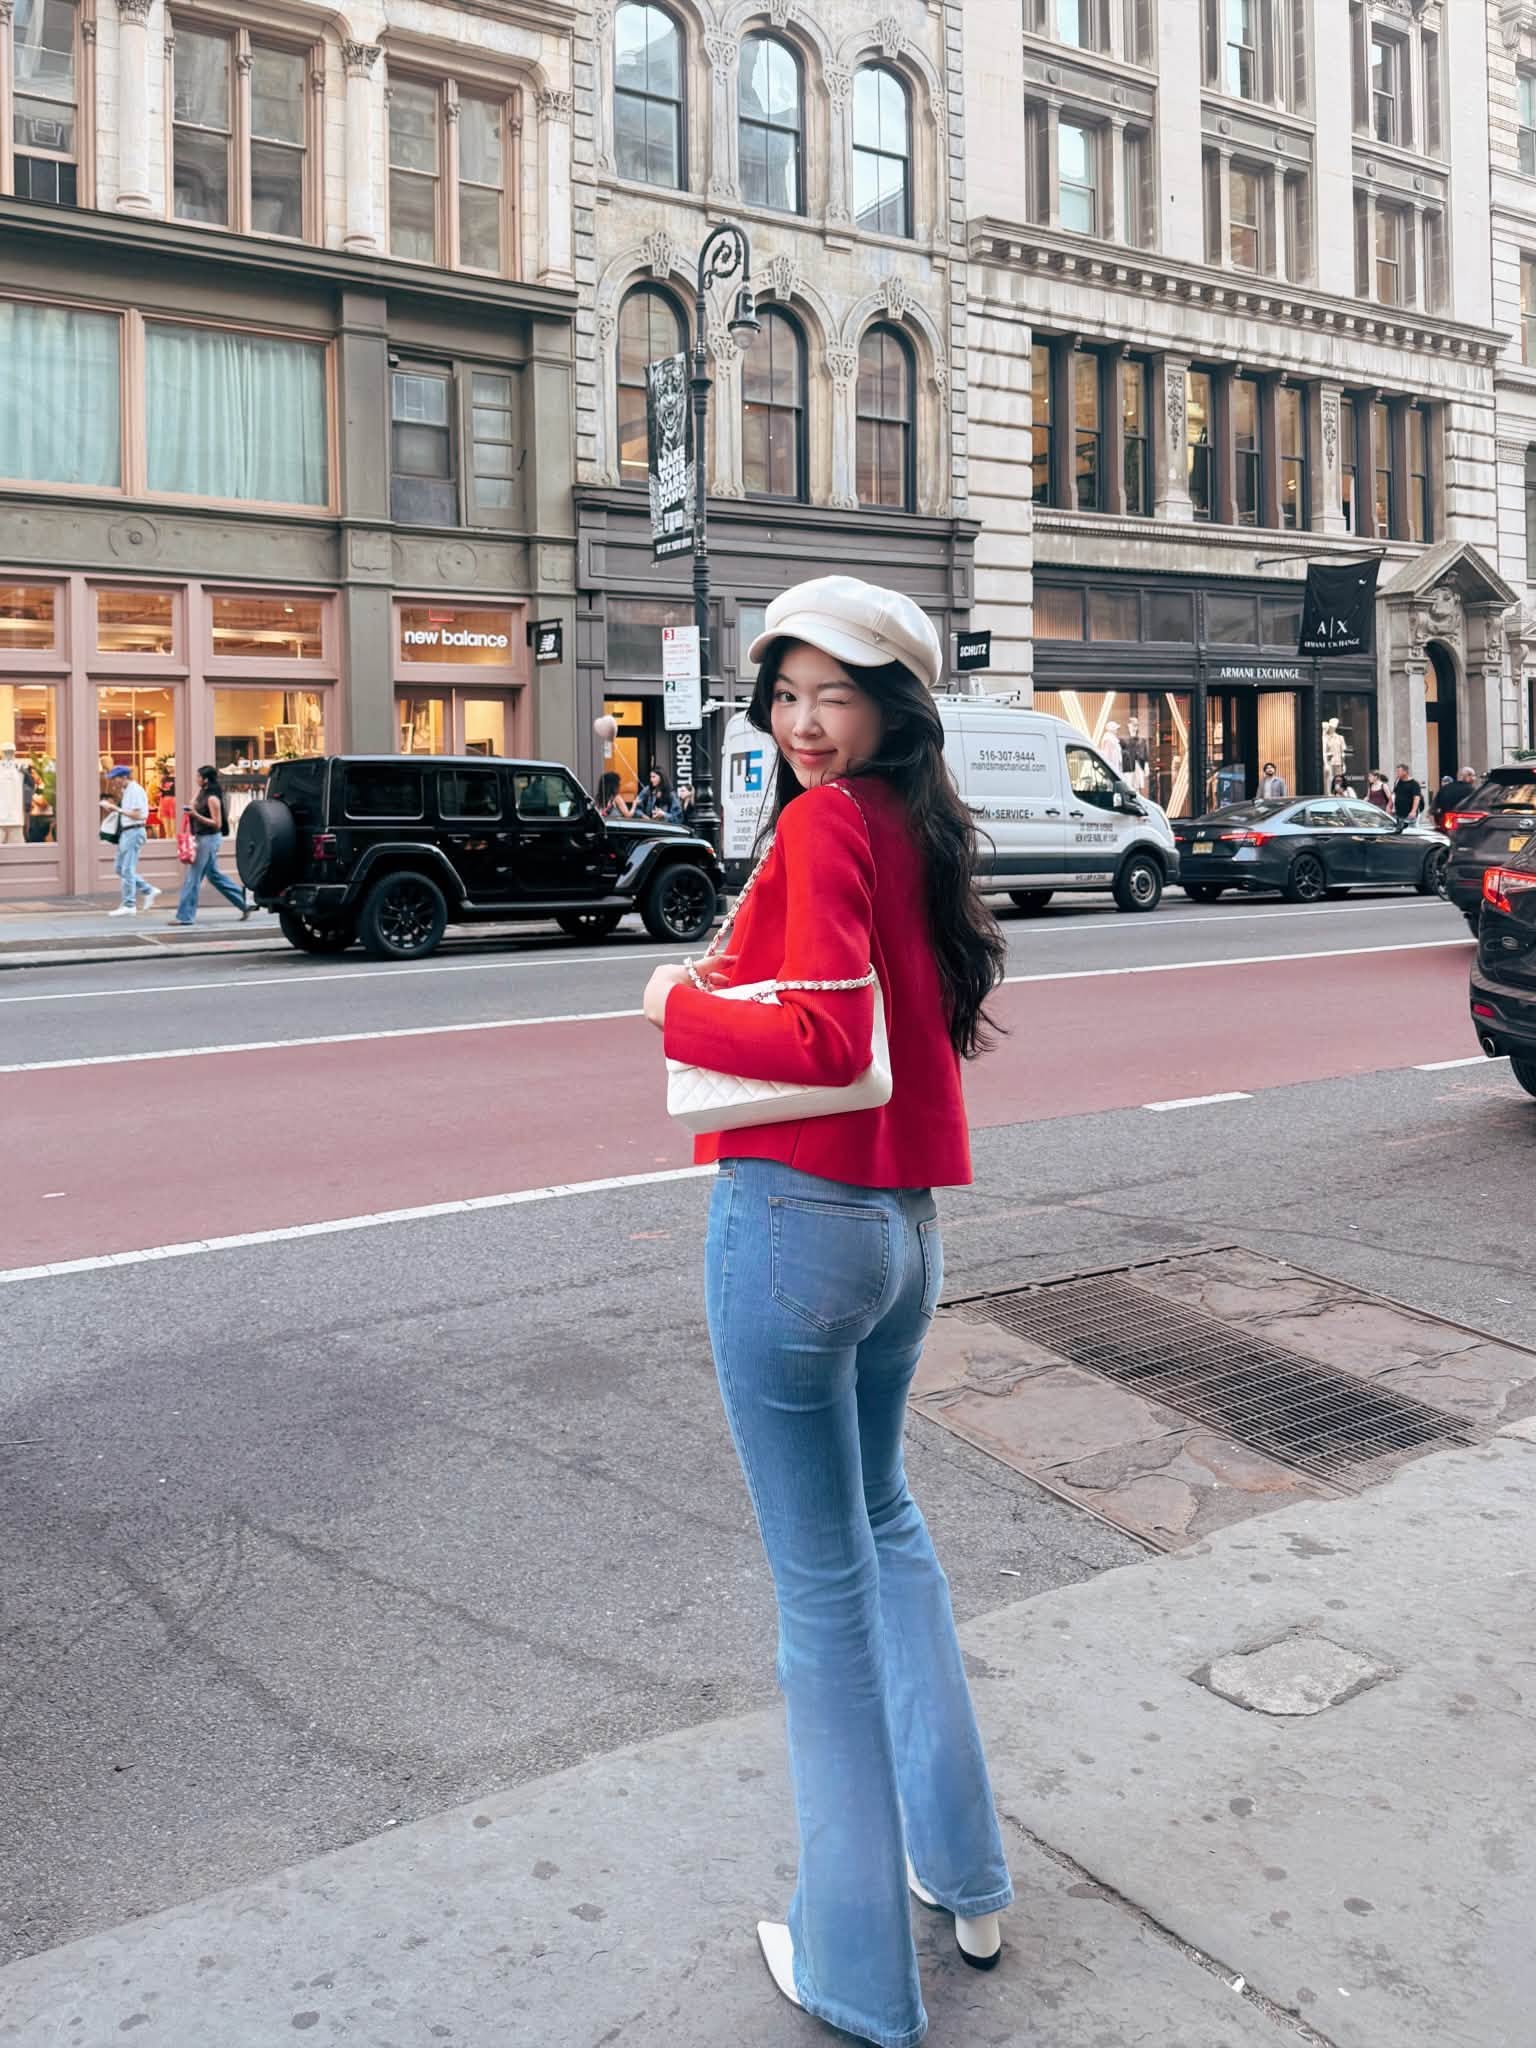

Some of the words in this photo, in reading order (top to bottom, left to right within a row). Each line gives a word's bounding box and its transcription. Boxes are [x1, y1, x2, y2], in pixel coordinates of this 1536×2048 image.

[658, 444, 685, 472] MAKE
[658, 459, 685, 484] YOUR
[659, 471, 686, 497] MARK
[660, 485, 687, 509] SOHO
[404, 630, 438, 645] new
[441, 629, 509, 648] balance
[960, 643, 987, 657] SCHUTZ
[1220, 667, 1254, 679] ARMANI
[1256, 667, 1300, 680] EXCHANGE
[676, 733, 692, 787] SCHUT
[979, 749, 1036, 761] 516-307-9444
